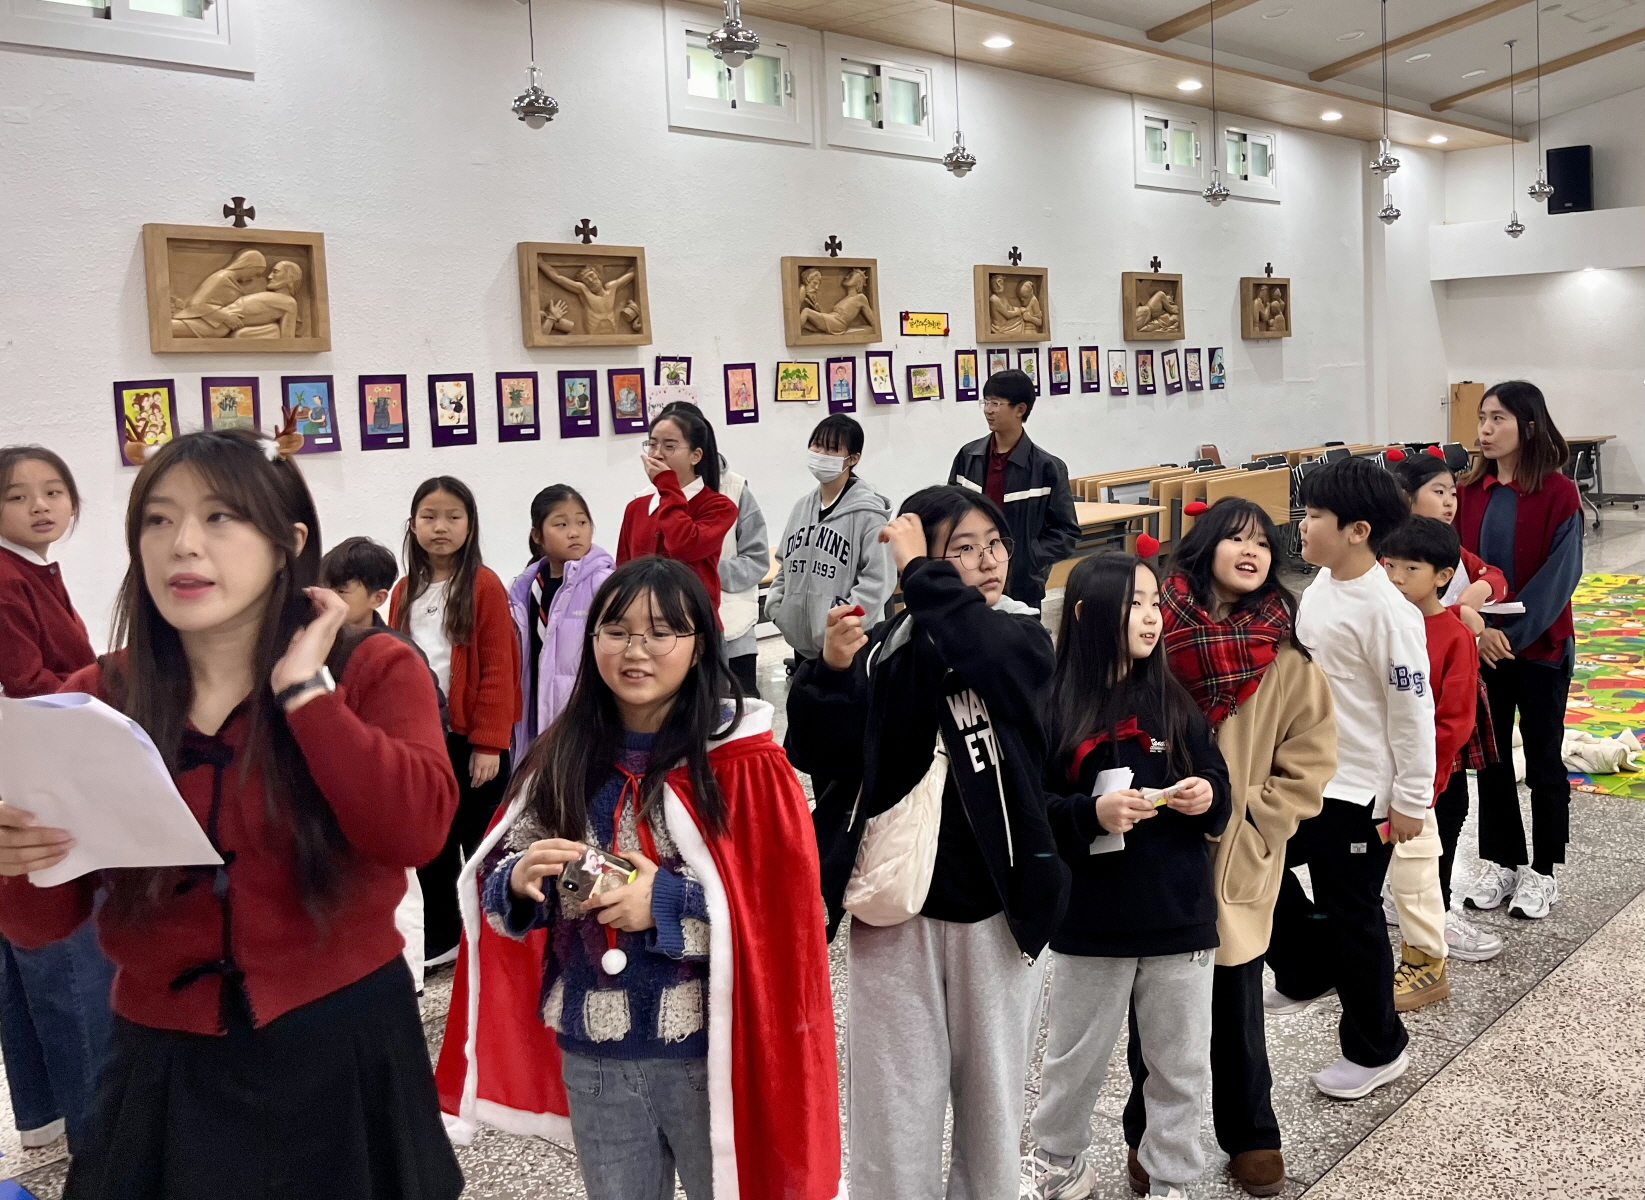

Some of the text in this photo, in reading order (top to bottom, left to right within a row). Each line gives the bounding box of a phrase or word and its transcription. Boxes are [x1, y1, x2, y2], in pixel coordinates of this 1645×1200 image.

[815, 526, 850, 566] NINE
[789, 559, 837, 579] ST 1993
